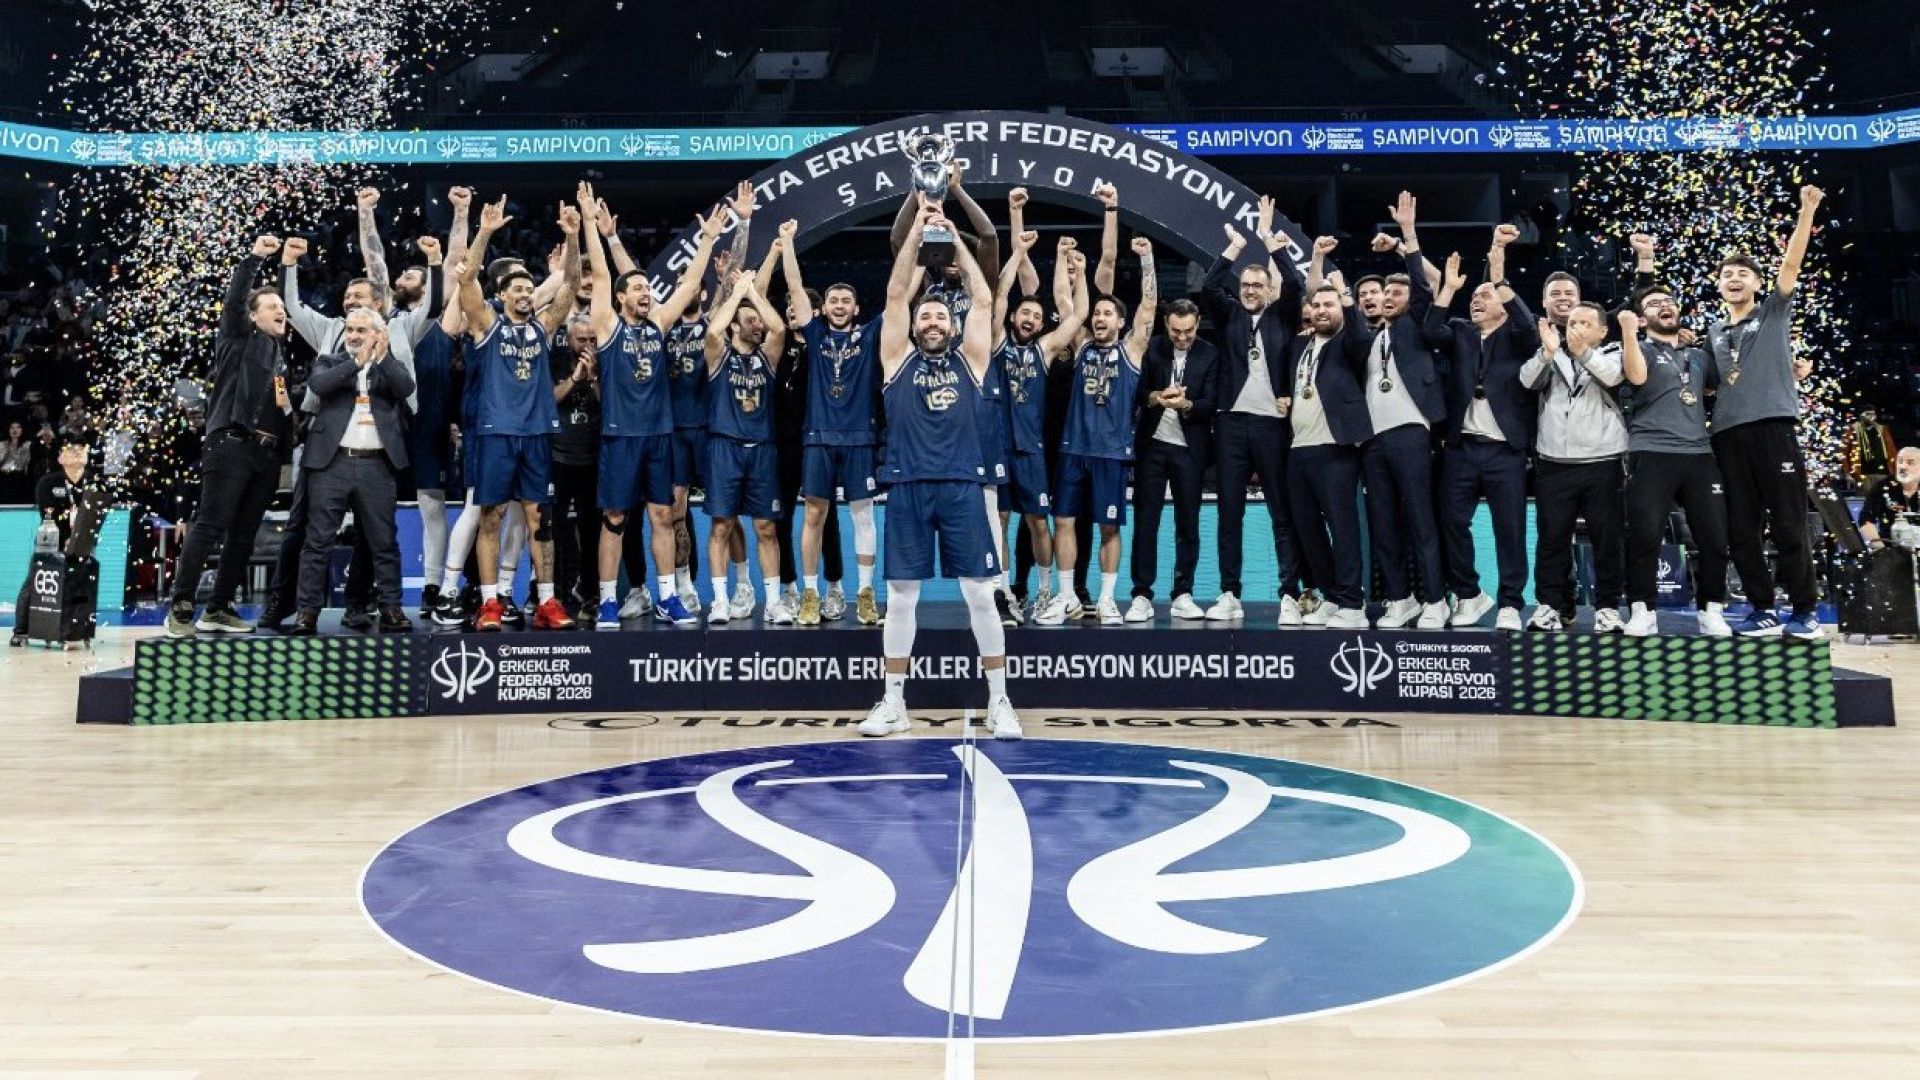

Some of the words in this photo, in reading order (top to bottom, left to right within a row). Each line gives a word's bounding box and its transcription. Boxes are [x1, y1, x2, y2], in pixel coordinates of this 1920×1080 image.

[805, 120, 989, 179] ERKEKER
[1000, 120, 1236, 210] FEDERASYON
[499, 659, 570, 673] ERKEKLER
[629, 652, 733, 682] TÜRKİYE
[737, 651, 842, 681] SİGORTA
[847, 656, 970, 680] ERKLER
[1141, 655, 1229, 679] KUPASI
[1235, 655, 1295, 679] 2026
[1398, 657, 1471, 671] ERKEKLER
[498, 673, 593, 687] FEDERASYON
[1398, 671, 1496, 686] FEDERASYON
[498, 687, 550, 701] KUPASI
[556, 687, 592, 700] 2026
[1398, 685, 1454, 699] KUPASI
[1458, 686, 1496, 699] 2026
